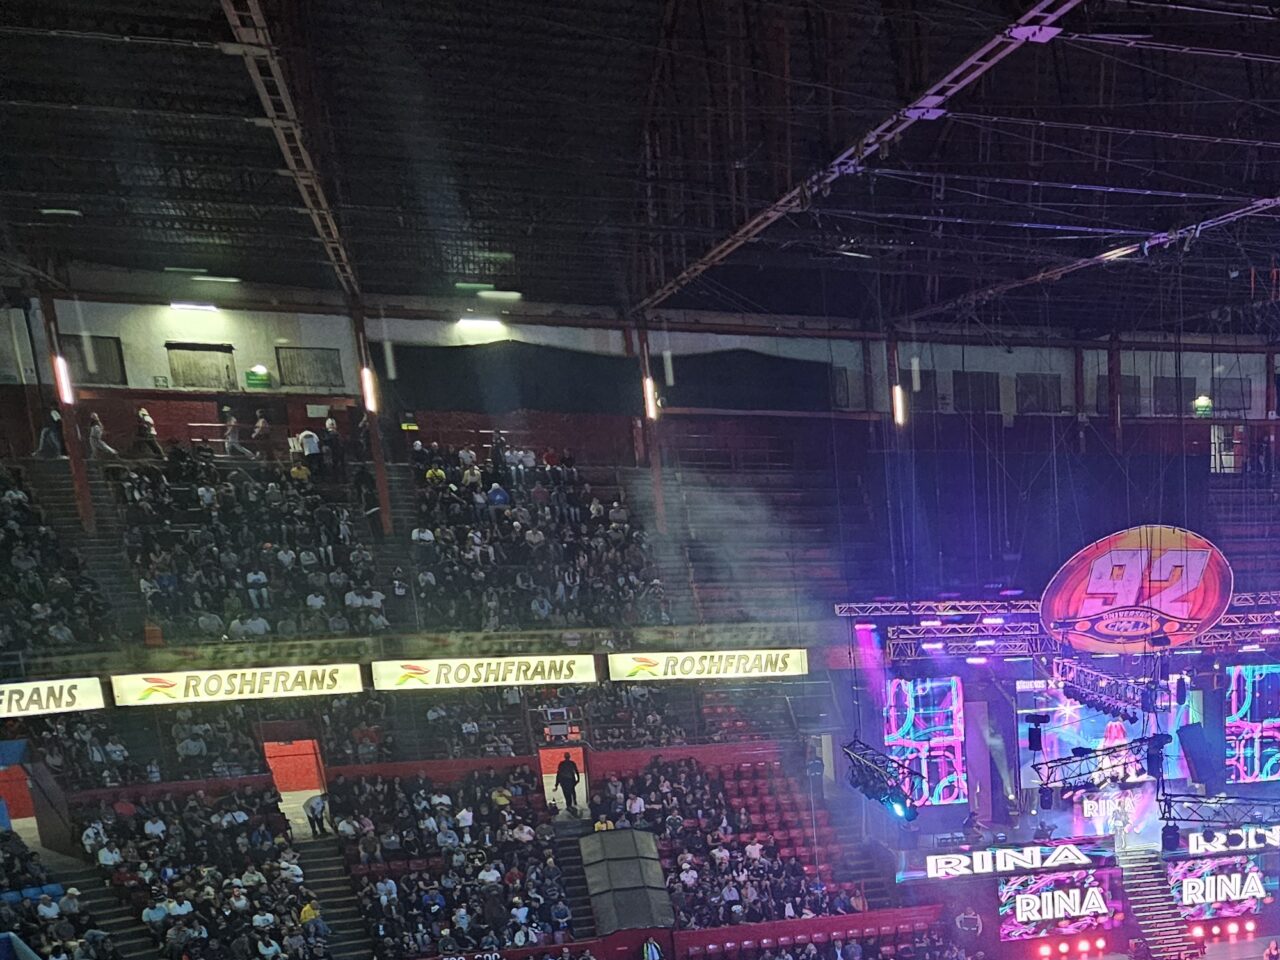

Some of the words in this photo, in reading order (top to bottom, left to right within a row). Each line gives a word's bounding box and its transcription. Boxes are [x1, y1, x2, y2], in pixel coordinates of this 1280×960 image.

[1077, 548, 1212, 618] 92
[435, 659, 576, 684] ROSHFRANS
[663, 653, 790, 675] ROSHFRANS
[184, 668, 339, 698] ROSHFRANS
[1083, 799, 1137, 818] RINA
[926, 843, 1092, 878] RINA
[1183, 873, 1266, 904] RINA
[1016, 887, 1109, 922] RINA
